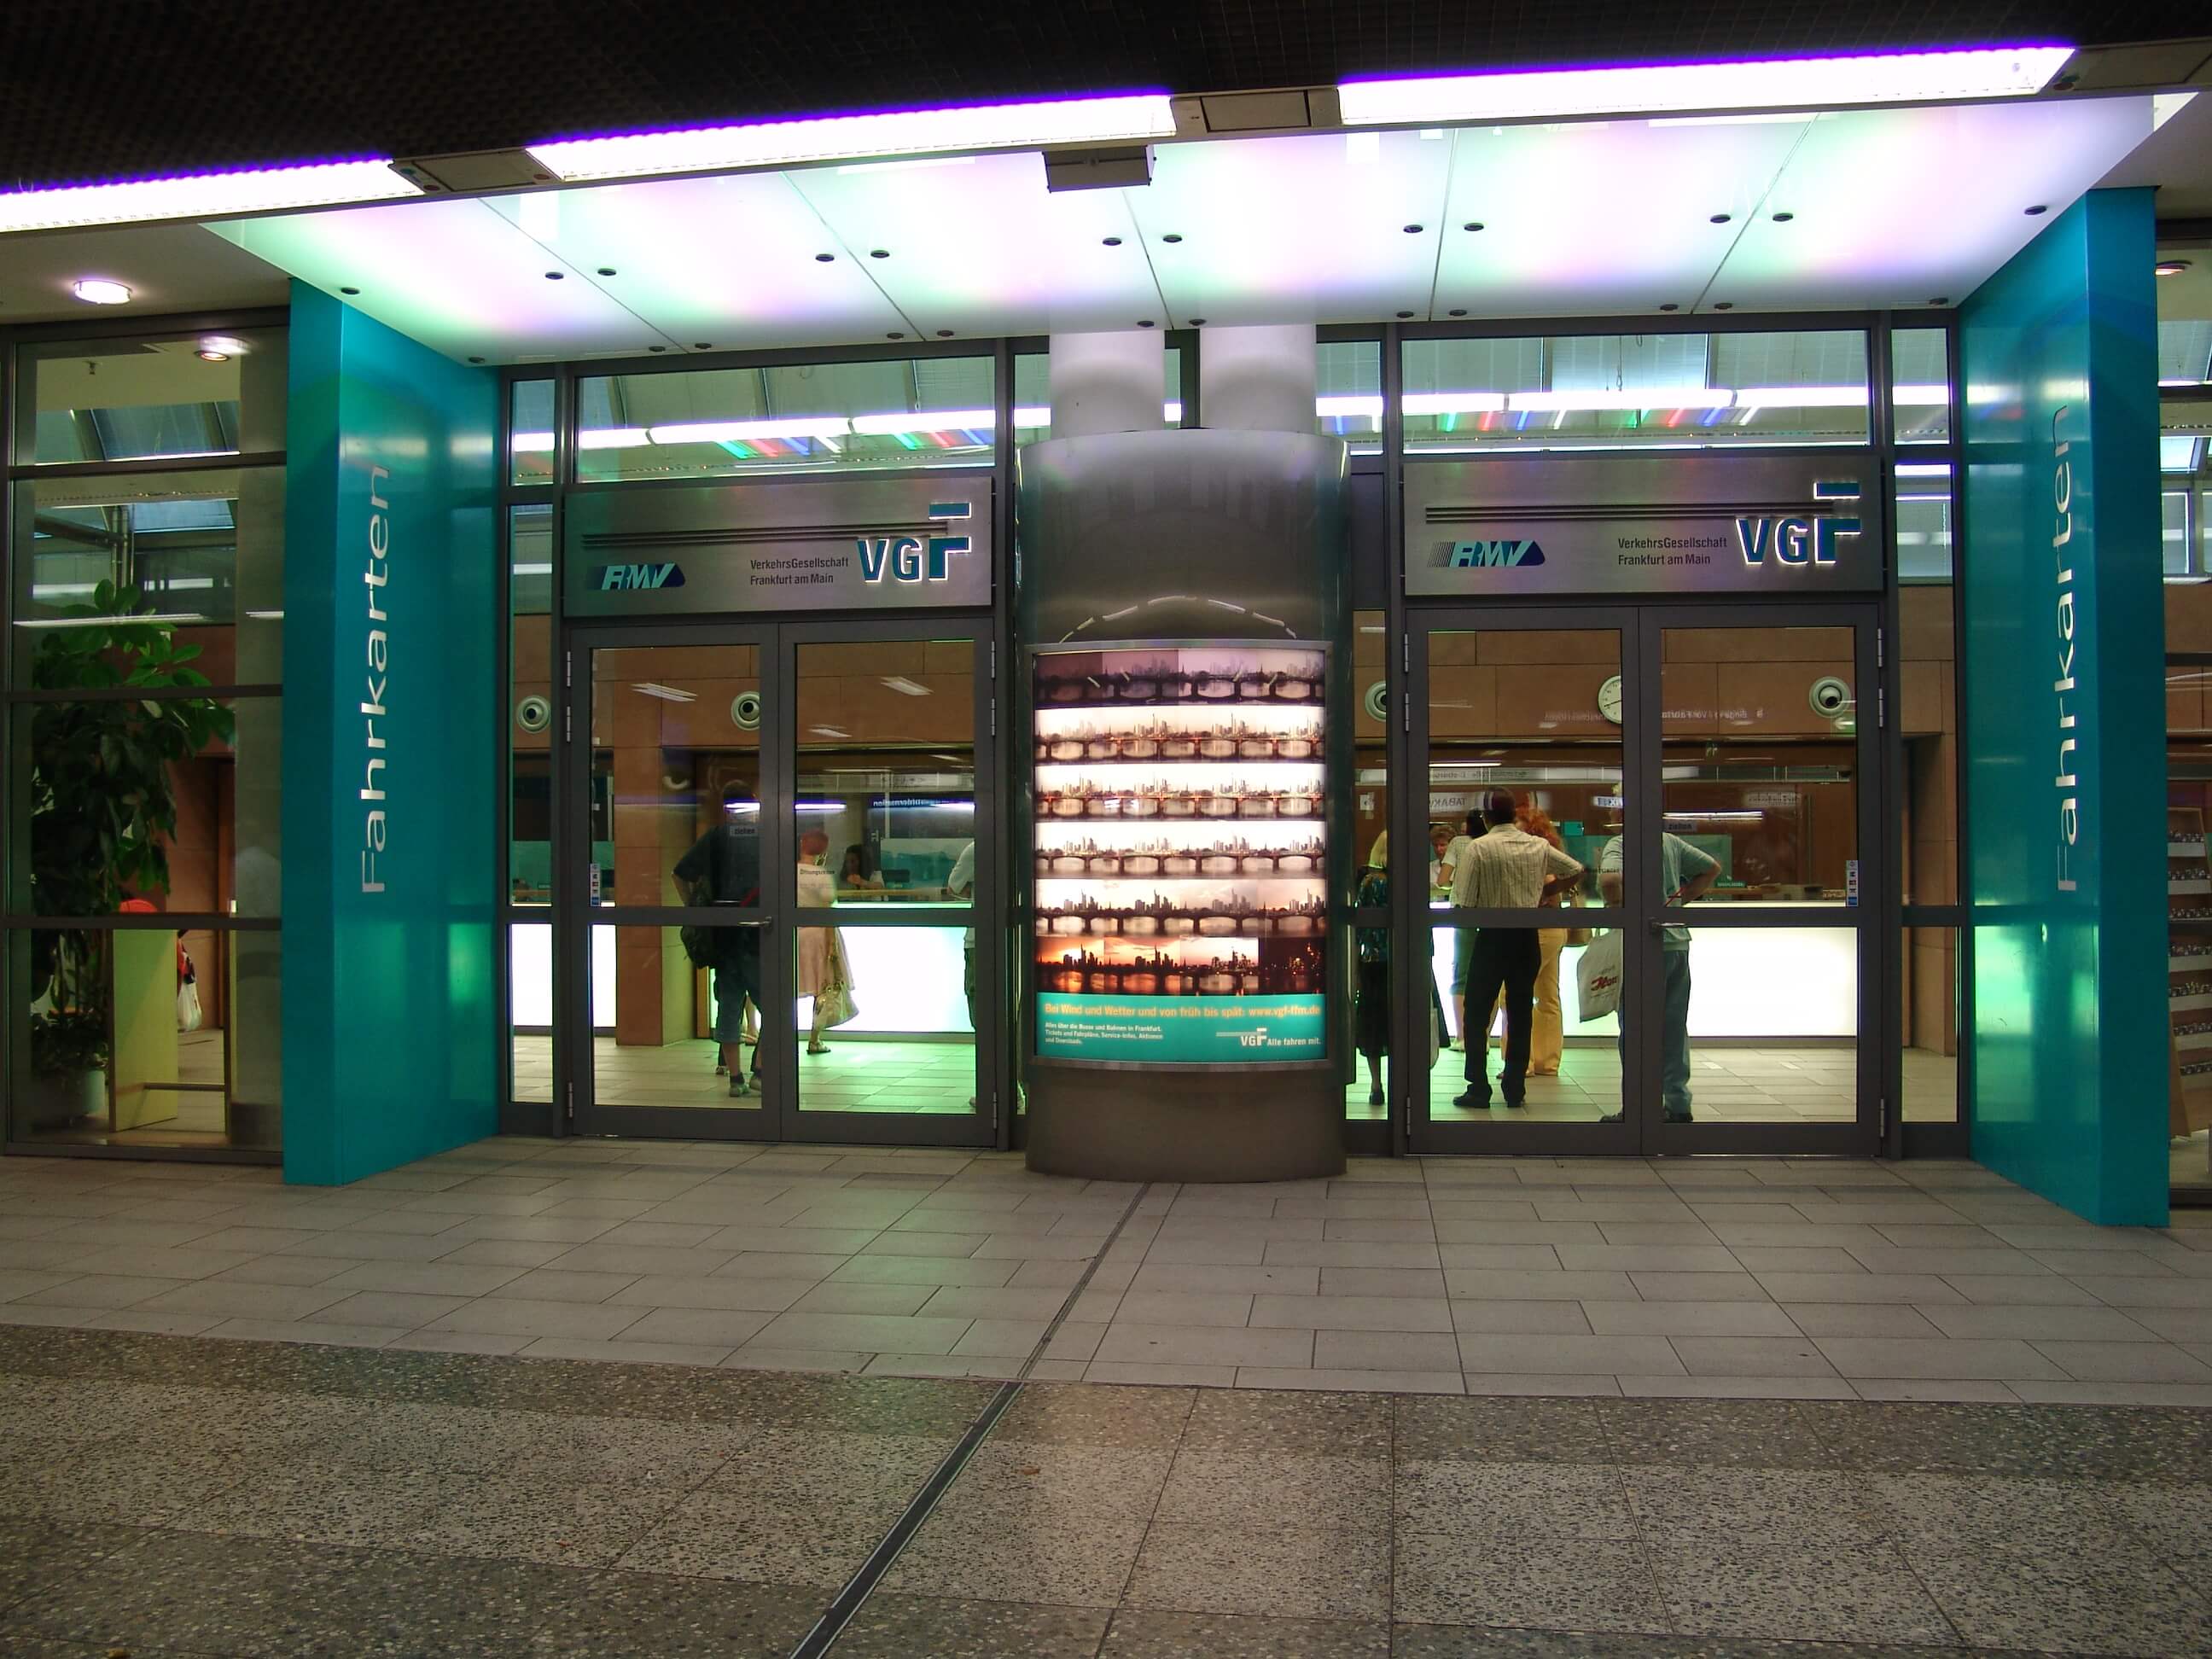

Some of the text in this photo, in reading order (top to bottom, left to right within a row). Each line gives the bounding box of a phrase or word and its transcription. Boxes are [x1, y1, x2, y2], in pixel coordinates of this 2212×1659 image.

[1735, 481, 1861, 565] VGF
[856, 502, 972, 583] VGF
[1617, 537, 1728, 549] VerkehrsGesellschaft
[750, 556, 849, 570] VerkehrsGesellschaft
[1617, 554, 1711, 566] Frankfurt am Main
[750, 573, 834, 586] Frankfurt am Main
[2052, 405, 2077, 891] Fahrkarten
[360, 464, 390, 893] Fahrkarten
[1045, 1003, 1058, 1014] Bei
[1061, 1004, 1082, 1015] Wind
[1086, 1005, 1102, 1016] und
[1104, 1004, 1134, 1016] Wetter
[1138, 1007, 1156, 1016] und
[1204, 1007, 1218, 1017] bis
[1240, 1027, 1322, 1046] VGF Alle fahren mit.
